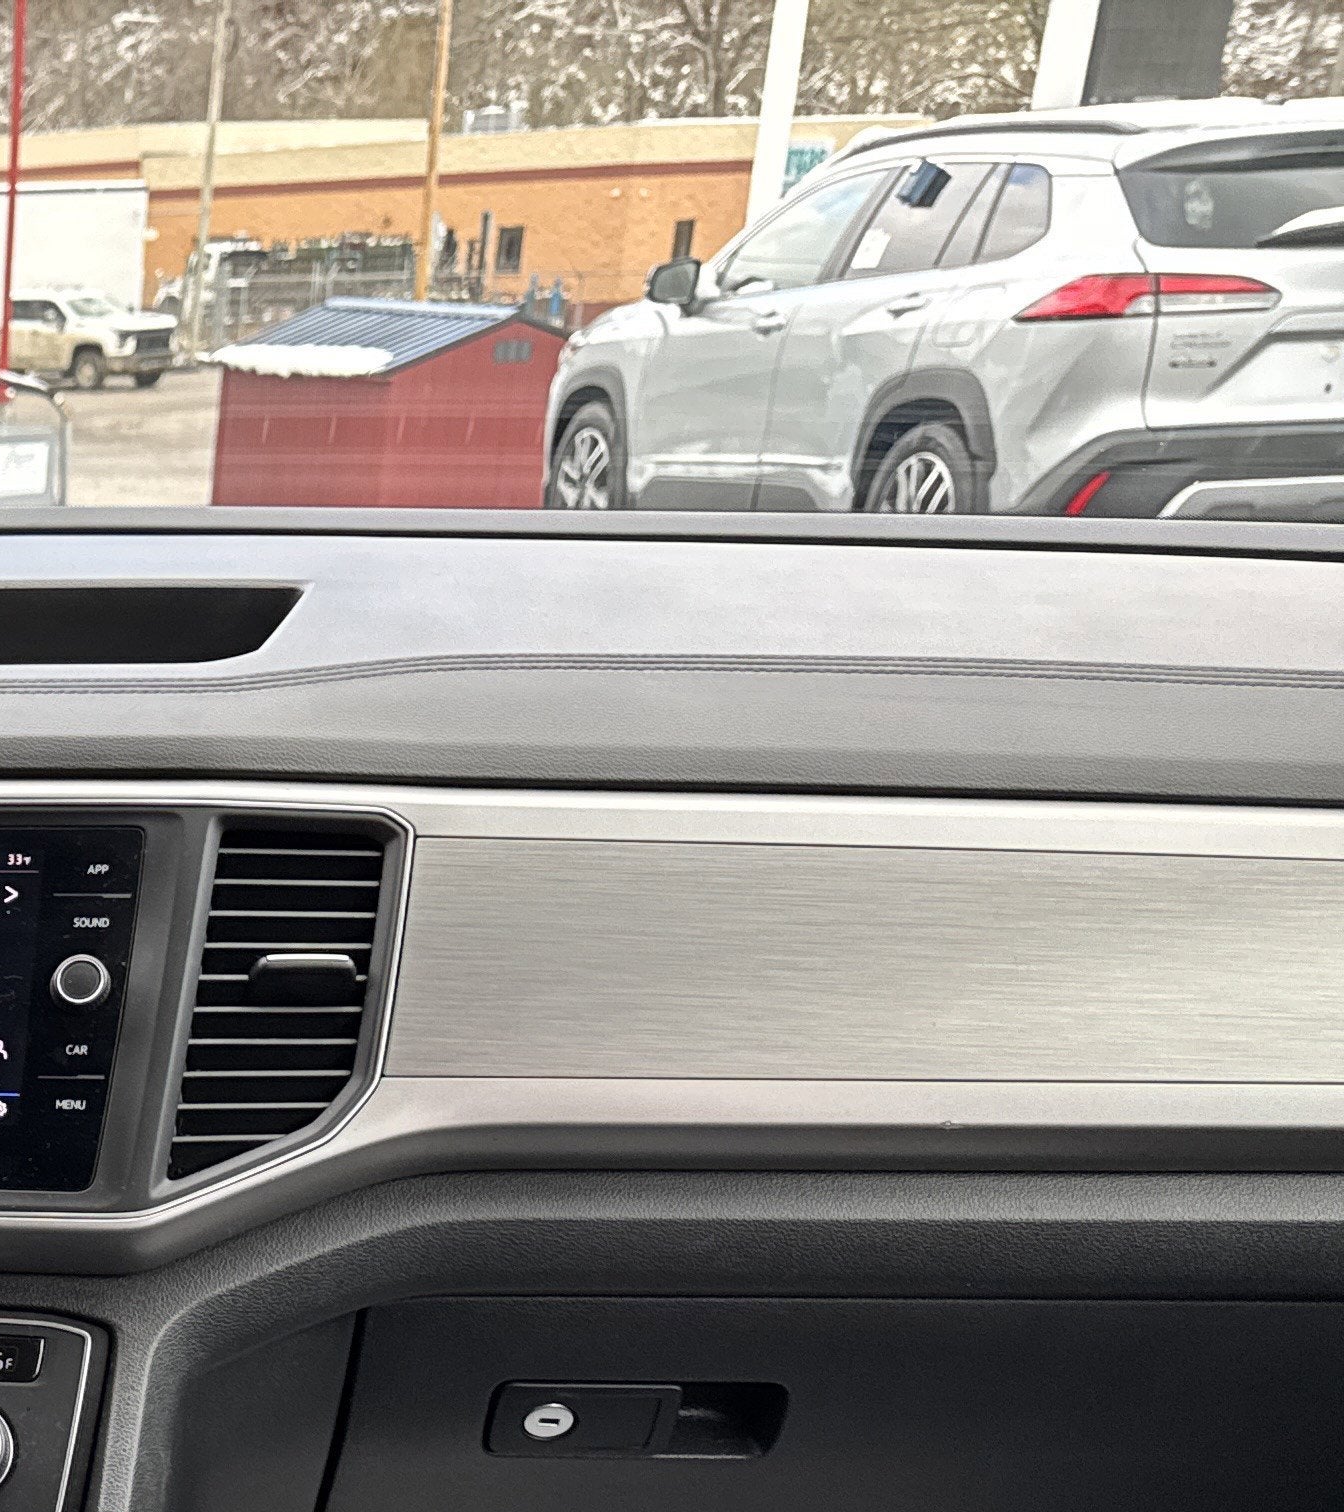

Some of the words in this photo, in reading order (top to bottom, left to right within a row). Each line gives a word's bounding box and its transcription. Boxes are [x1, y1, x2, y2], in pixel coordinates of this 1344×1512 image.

[86, 864, 110, 875] APP
[72, 917, 110, 928] SOUND
[65, 1044, 89, 1056] CAR
[55, 1099, 87, 1110] MENU
